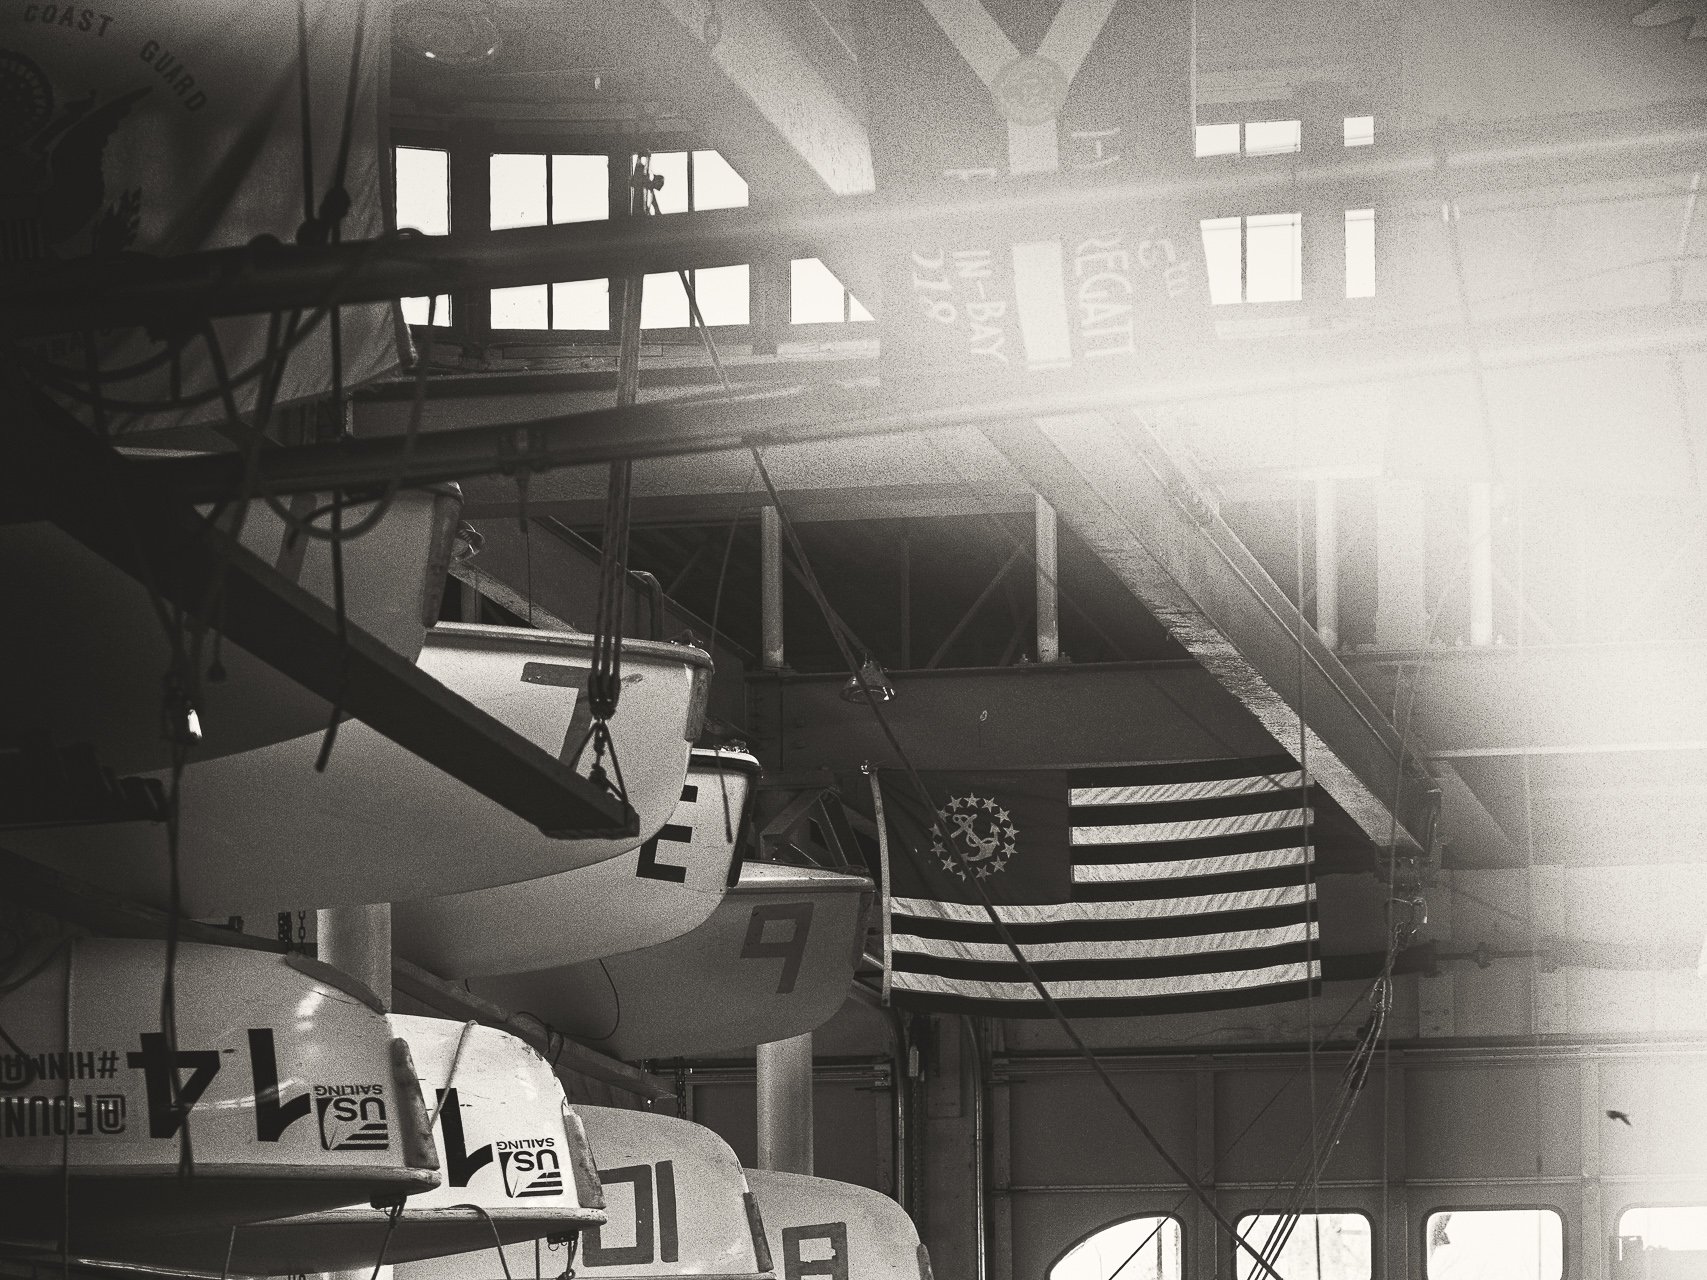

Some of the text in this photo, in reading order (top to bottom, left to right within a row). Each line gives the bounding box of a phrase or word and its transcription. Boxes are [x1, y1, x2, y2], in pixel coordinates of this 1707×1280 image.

[24, 4, 208, 112] COAST GUARD
[741, 901, 814, 994] 9
[126, 1028, 312, 1143] 14
[314, 1084, 384, 1098] SAILING
[333, 1097, 388, 1123] US
[496, 1137, 555, 1151] SAILING
[513, 1149, 560, 1172] US
[582, 1159, 679, 1268] 10
